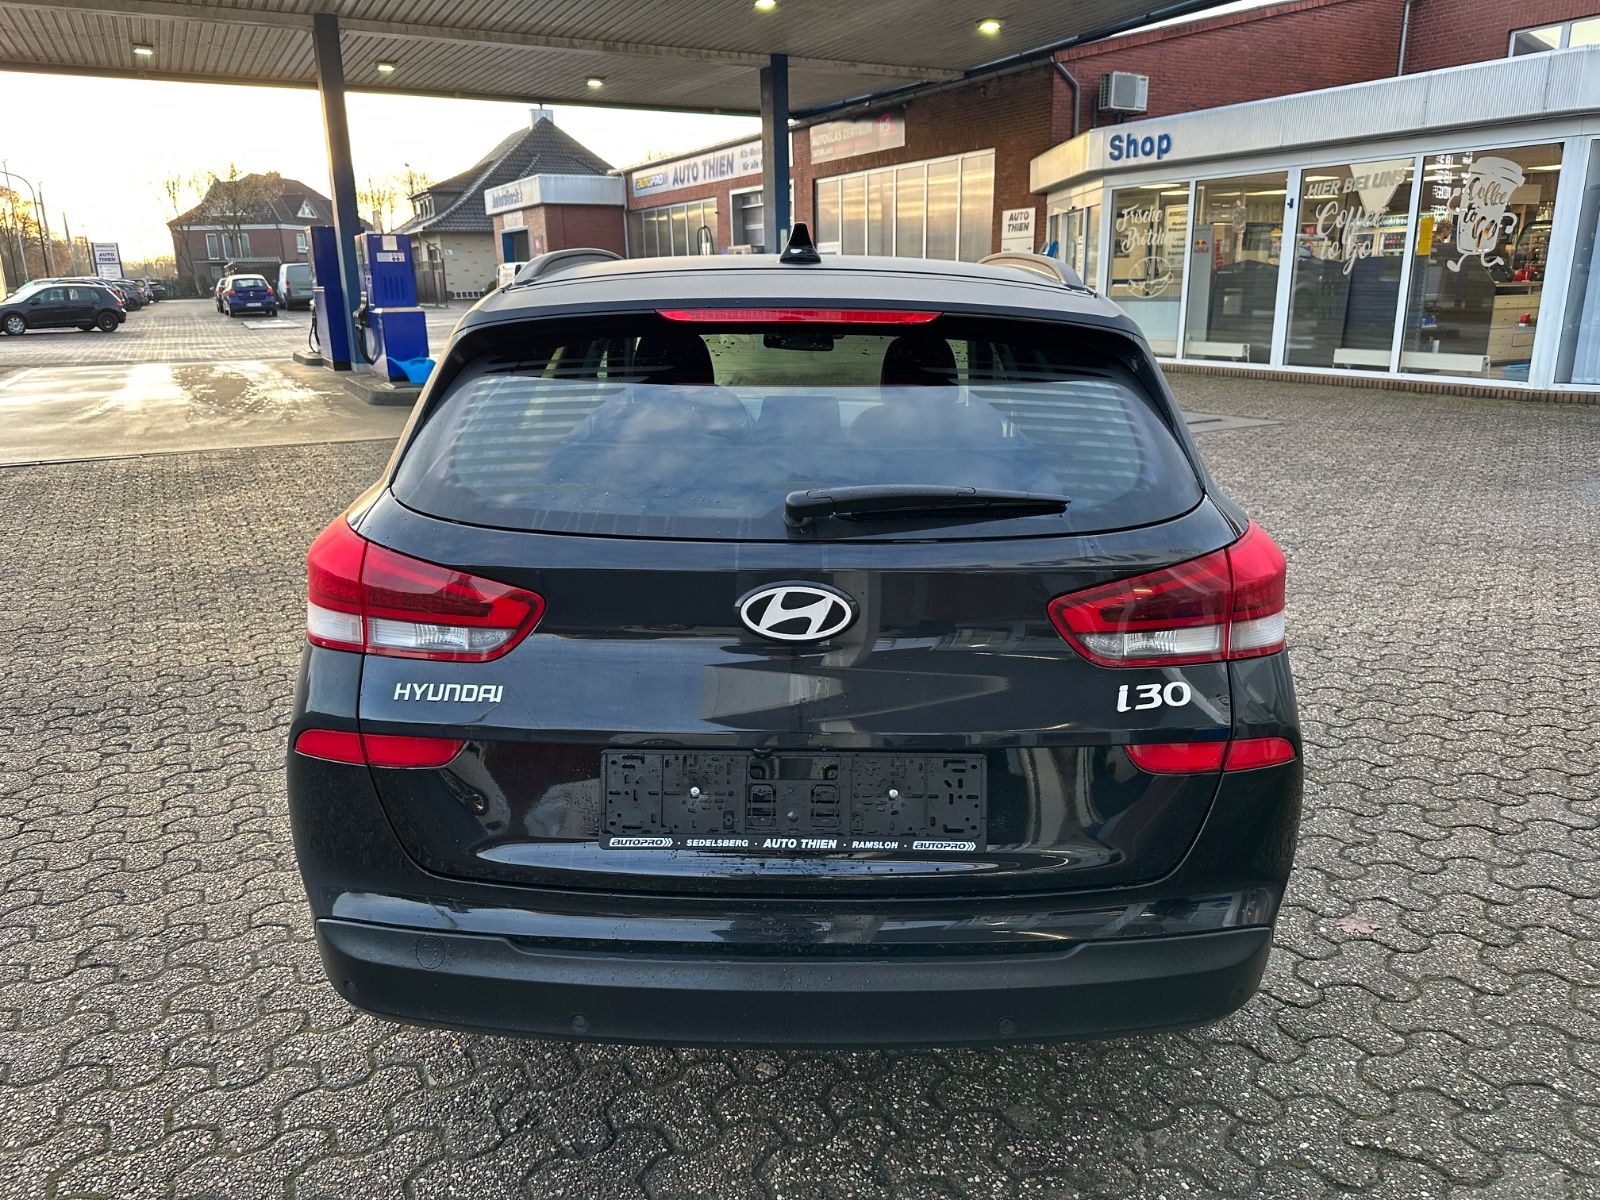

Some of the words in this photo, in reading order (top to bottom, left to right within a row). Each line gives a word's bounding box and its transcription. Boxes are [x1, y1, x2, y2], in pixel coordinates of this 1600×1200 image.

[1109, 133, 1171, 161] Shop
[672, 163, 699, 187] AUTO
[702, 153, 735, 180] THIEN
[1307, 180, 1341, 197] HIER
[1342, 174, 1370, 194] BEI
[1372, 169, 1407, 188] UNS
[1469, 176, 1508, 206] Coffee
[1007, 222, 1030, 232] THIEN
[1009, 211, 1030, 222] AUTO
[1116, 203, 1163, 233] Frische
[1316, 201, 1390, 246] Coffee
[1464, 203, 1480, 224] to
[1319, 236, 1342, 260] to
[1343, 241, 1372, 275] go
[393, 682, 504, 703] HYUNDAI
[1117, 681, 1192, 712] i30
[686, 839, 749, 847] SEDELSBERG
[763, 838, 797, 849] AUTO
[800, 838, 837, 849] THIEN
[851, 840, 899, 849] RAMSLOH
